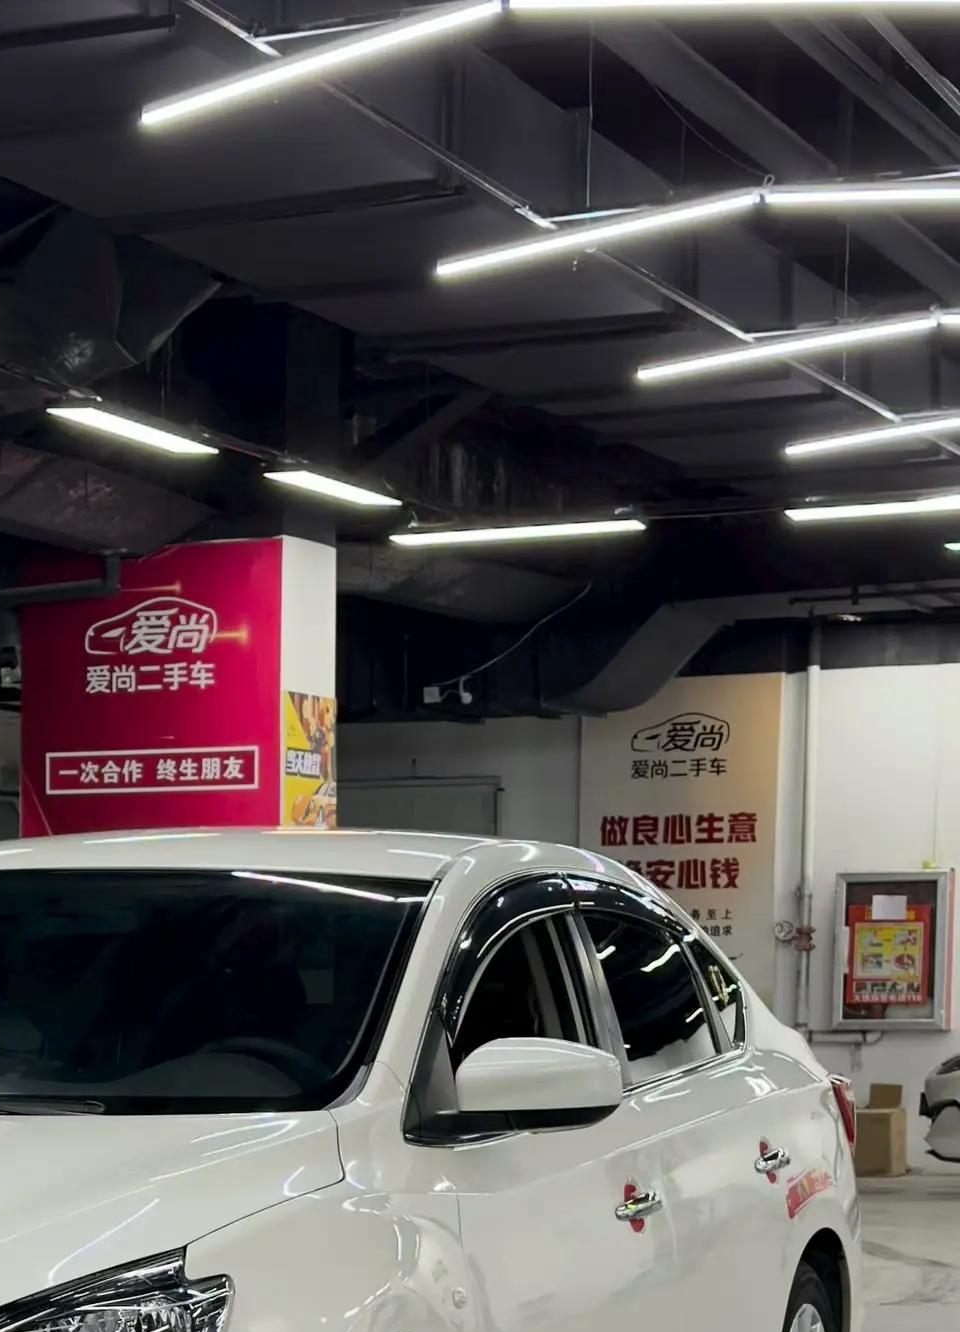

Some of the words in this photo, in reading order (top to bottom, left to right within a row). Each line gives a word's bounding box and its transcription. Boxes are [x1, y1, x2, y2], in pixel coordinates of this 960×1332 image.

[125, 607, 210, 654] 爱尚
[86, 661, 215, 693] 爱尚二手车
[661, 720, 725, 751] 爱尚
[59, 760, 144, 784] 一次合作
[156, 756, 244, 782] 终生朋友
[631, 758, 727, 779] 爱尚二手车
[600, 812, 758, 846] 做良心生意
[626, 858, 740, 889] 安心钱
